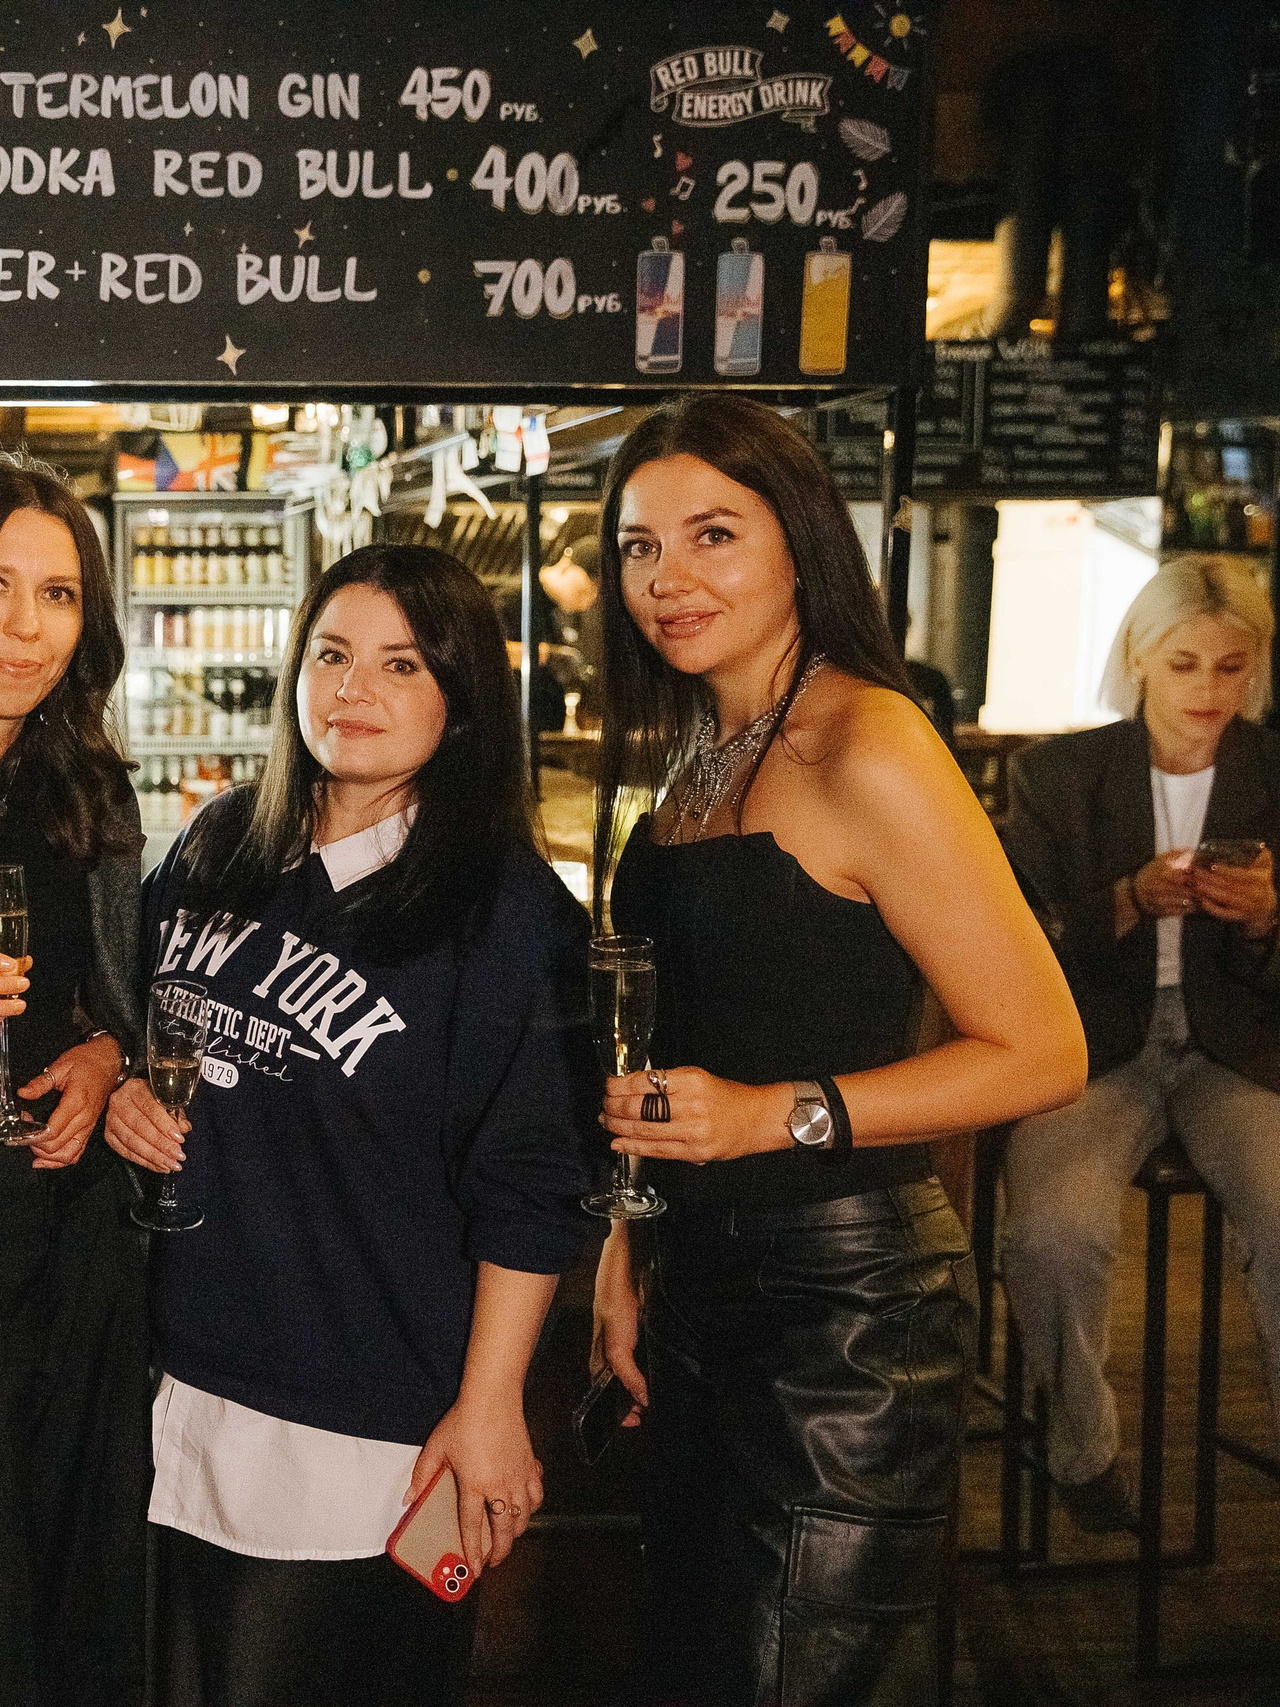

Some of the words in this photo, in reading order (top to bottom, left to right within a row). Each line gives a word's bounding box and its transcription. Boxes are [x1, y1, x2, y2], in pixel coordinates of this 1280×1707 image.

[277, 73, 360, 120] GIN
[400, 66, 491, 122] 450
[656, 56, 699, 91] RED
[703, 50, 754, 77] BULL
[681, 89, 754, 120] ENERGY
[758, 79, 824, 111] DRINK
[153, 150, 263, 198] RED
[295, 148, 433, 200] BULL
[471, 145, 581, 216] 400
[713, 160, 819, 224] 250
[236, 252, 378, 304] BULL
[473, 257, 576, 320] 700
[252, 930, 407, 1078] YORK
[244, 1015, 292, 1059] DEPT
[203, 1060, 235, 1085] 1979
